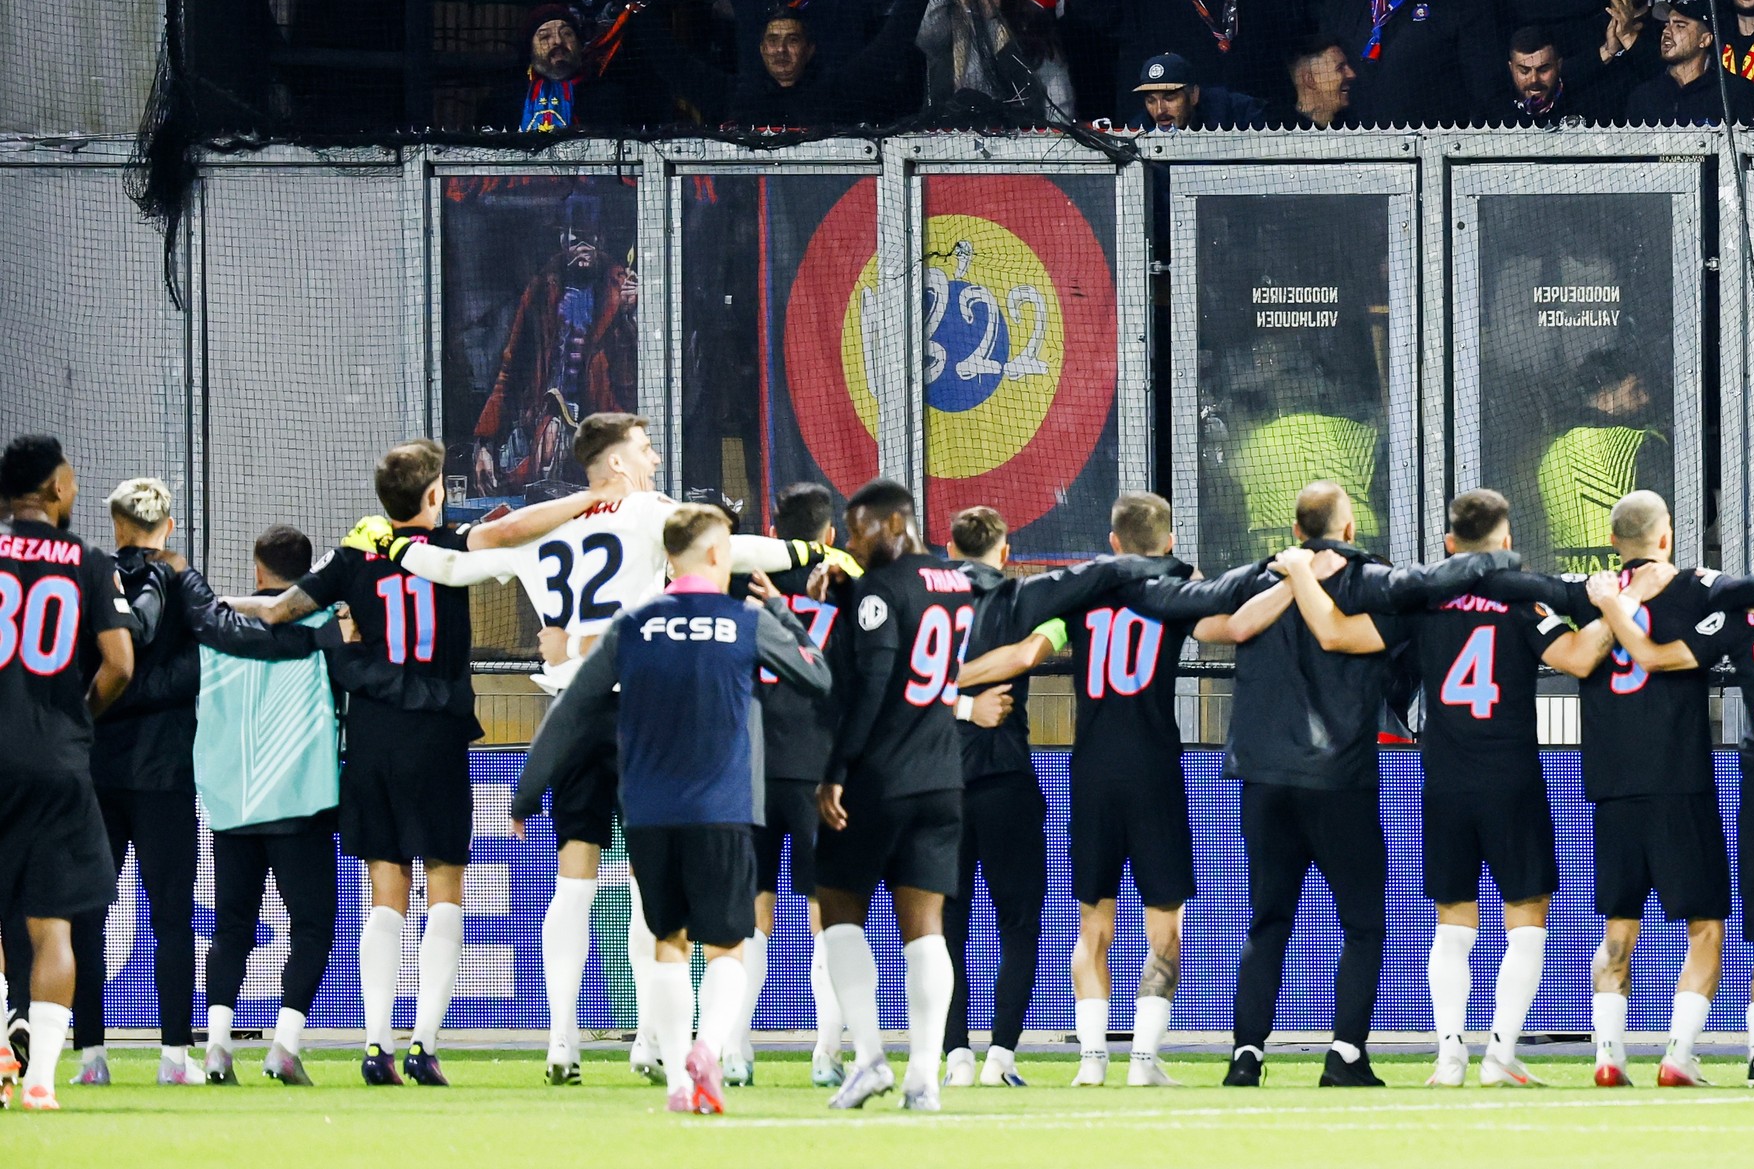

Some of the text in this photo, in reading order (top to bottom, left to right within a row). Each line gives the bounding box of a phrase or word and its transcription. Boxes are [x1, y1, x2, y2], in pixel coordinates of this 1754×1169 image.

[376, 573, 436, 665] 11
[538, 532, 624, 631] 32
[639, 615, 738, 644] FCSB
[1085, 606, 1165, 700] 10
[1440, 624, 1500, 720] 4
